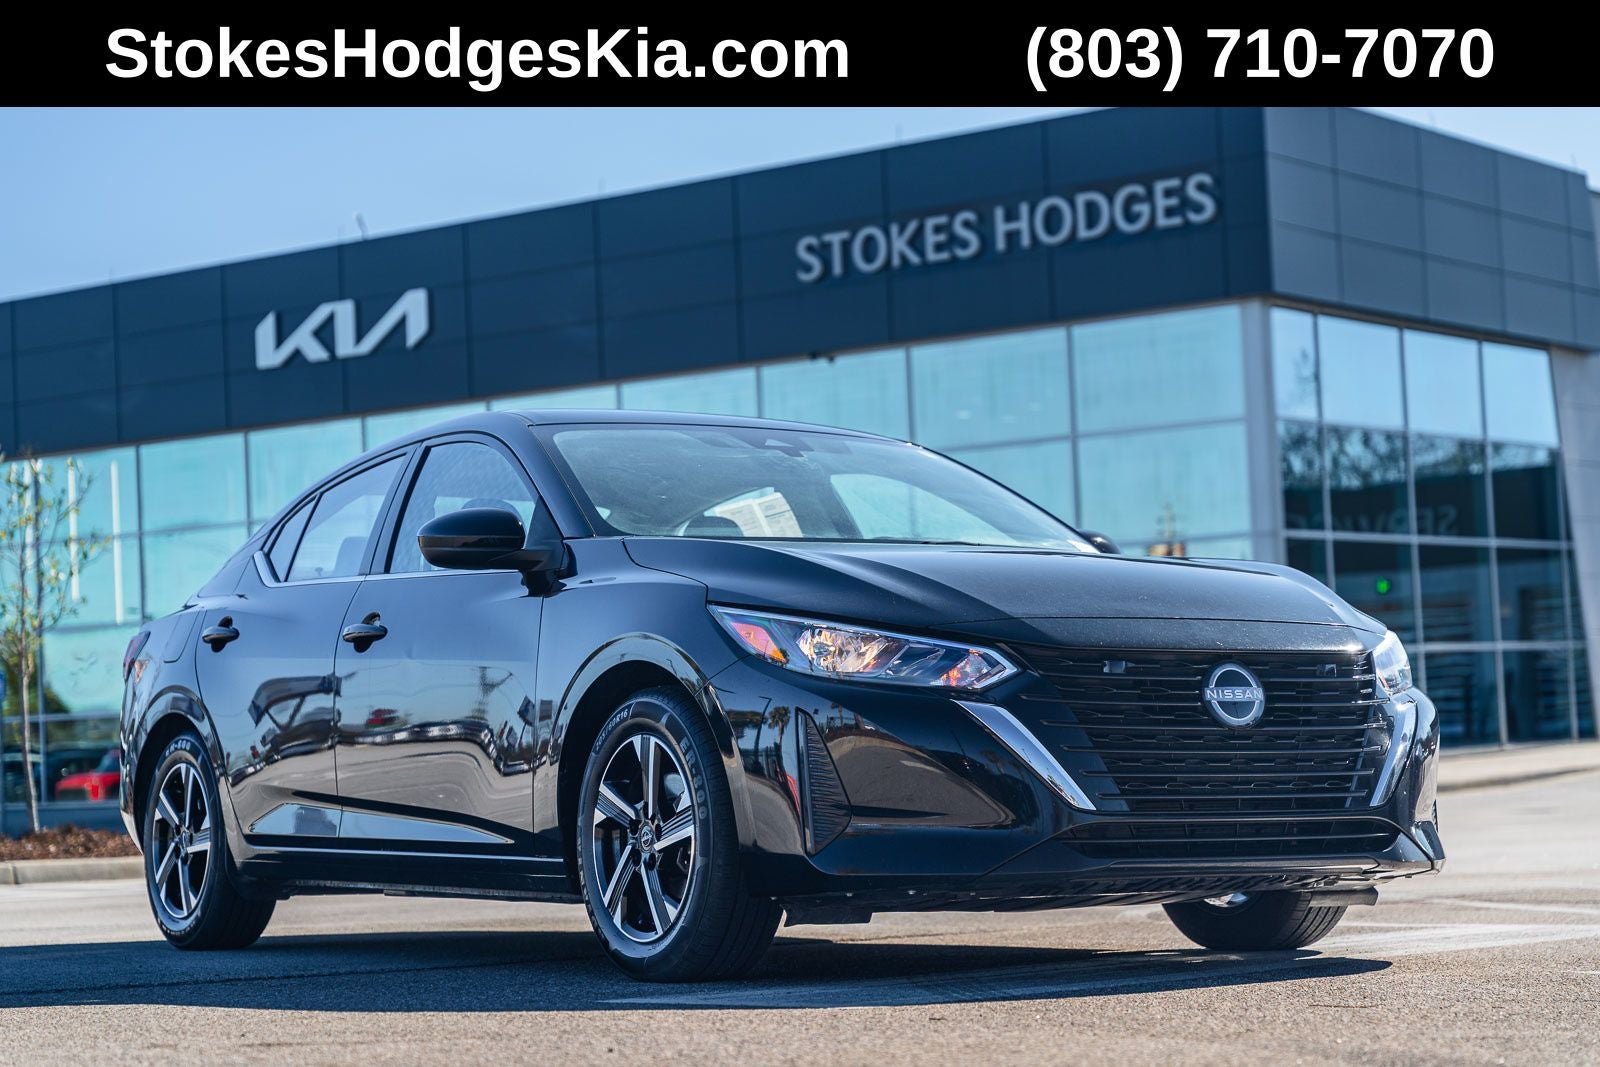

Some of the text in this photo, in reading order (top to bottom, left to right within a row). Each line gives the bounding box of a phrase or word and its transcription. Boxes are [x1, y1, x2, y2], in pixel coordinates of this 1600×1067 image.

[796, 172, 1217, 283] STOKES HODGES
[254, 286, 430, 371] KIA
[1206, 689, 1263, 699] NISSAN
